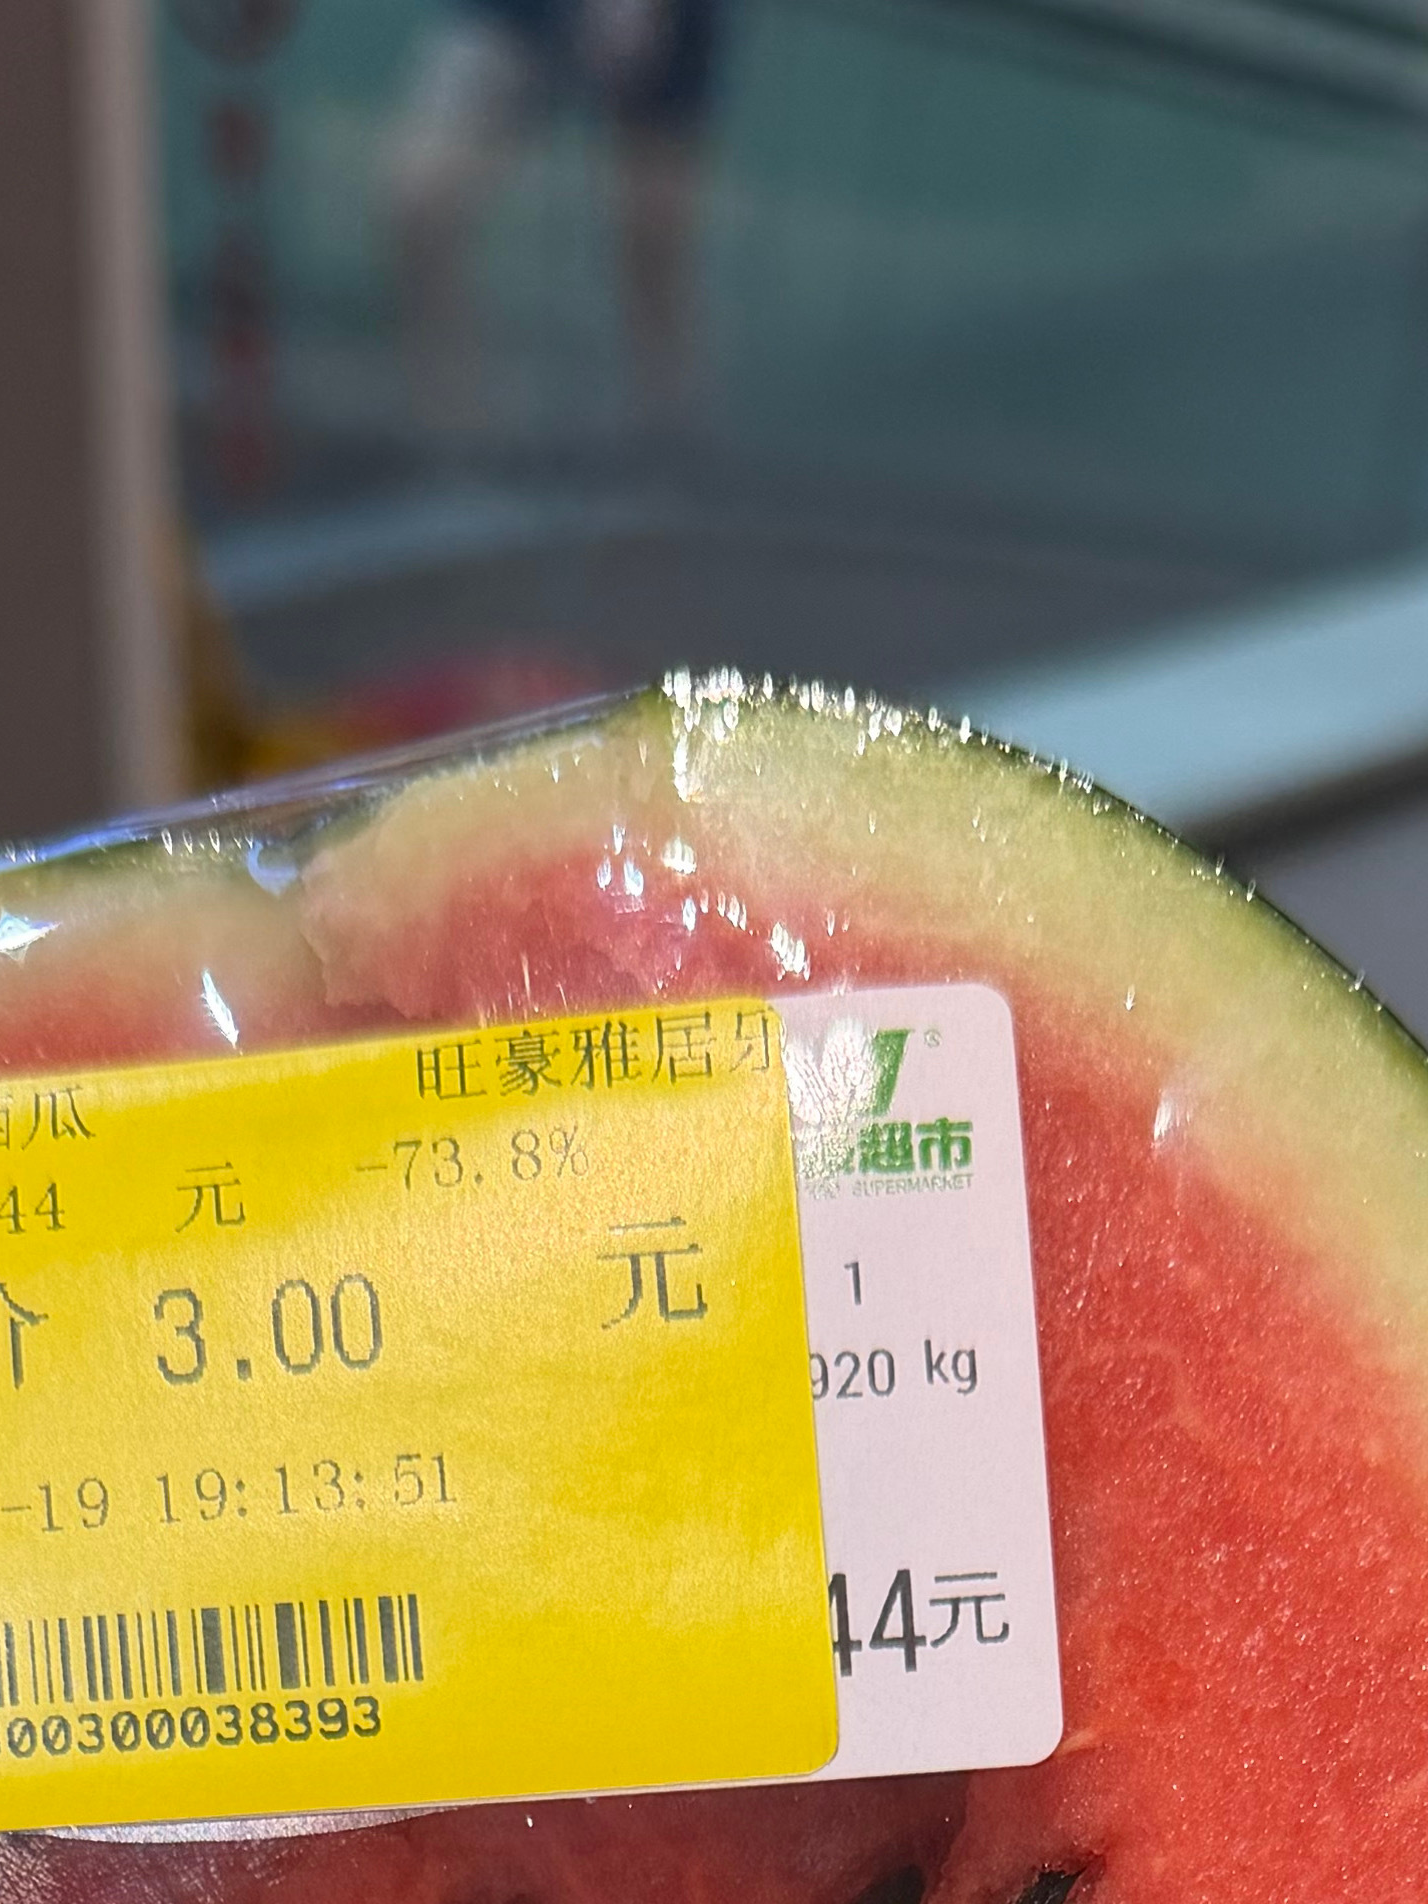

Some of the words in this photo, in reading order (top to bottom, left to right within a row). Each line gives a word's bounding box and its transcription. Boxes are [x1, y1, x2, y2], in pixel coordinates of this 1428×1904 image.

[176, 1162, 246, 1232] 元
[356, 1125, 590, 1191] -73.8%
[852, 1172, 973, 1198] SUPERMARKET
[153, 1273, 383, 1386] 3.00
[596, 1216, 708, 1330] 元
[844, 1260, 862, 1306] 1
[924, 1339, 978, 1396] kg
[156, 1452, 458, 1526] 19:13:51
